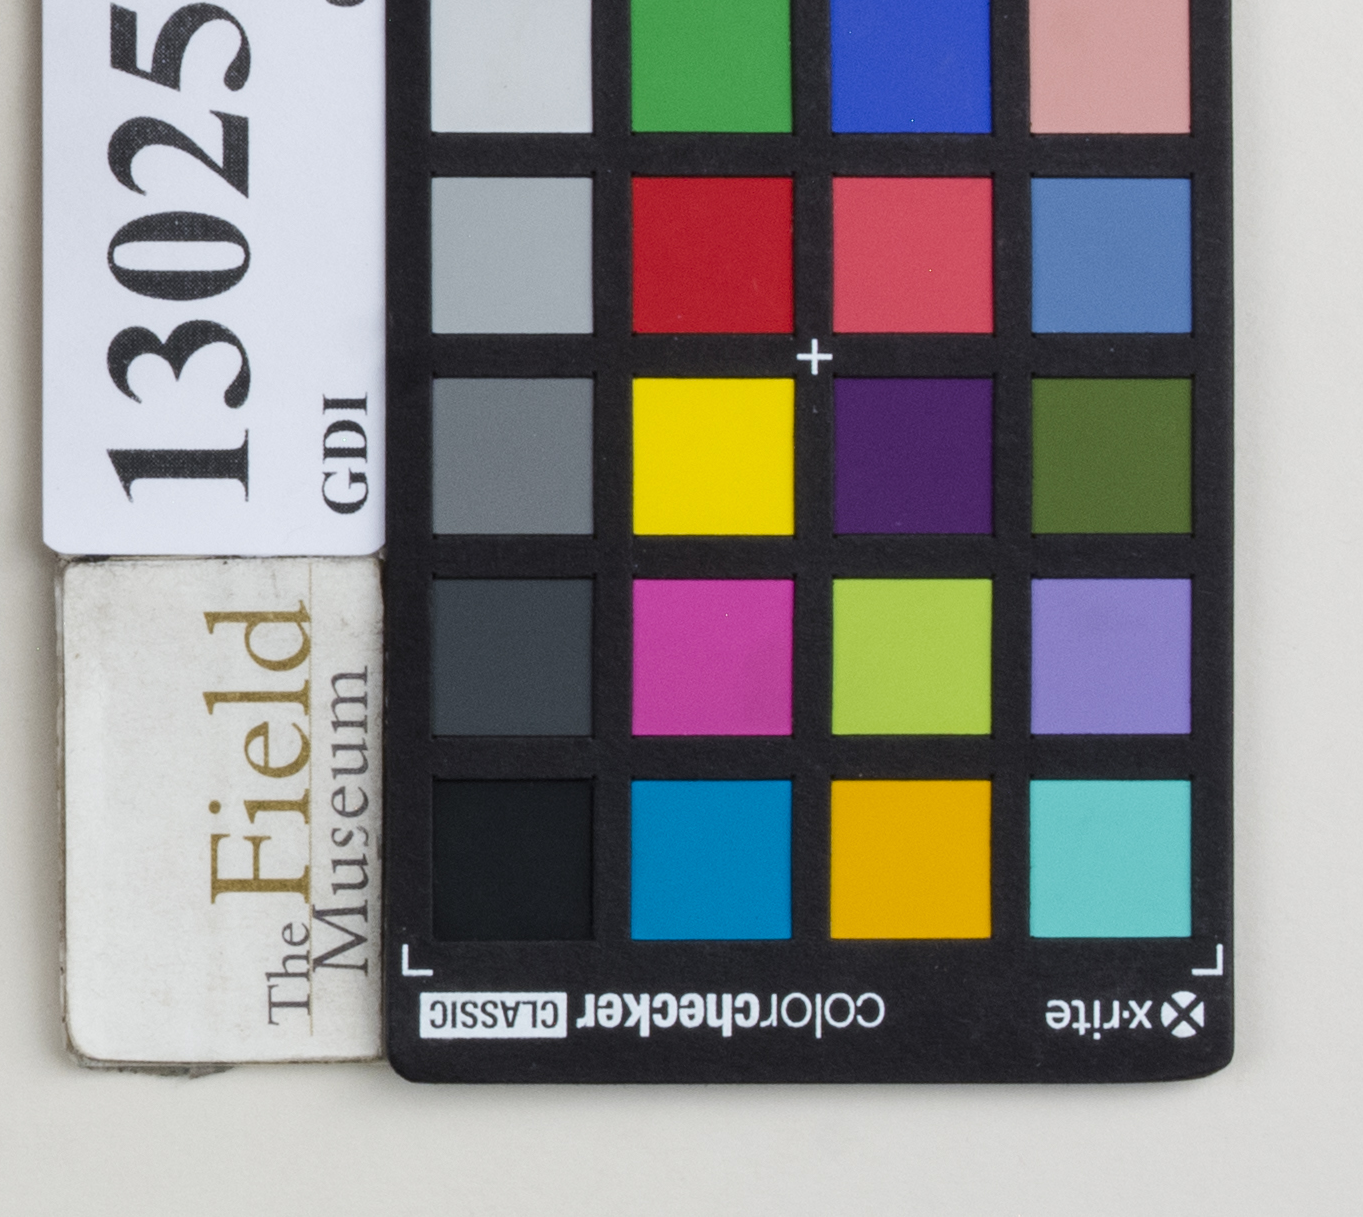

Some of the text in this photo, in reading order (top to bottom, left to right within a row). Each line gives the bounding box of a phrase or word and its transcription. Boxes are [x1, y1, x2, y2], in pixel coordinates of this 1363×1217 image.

[322, 397, 369, 515] GDI
[203, 601, 310, 1025] The Field
[312, 666, 370, 978] Museum
[430, 992, 886, 1039] colorchecker CLASSIC
